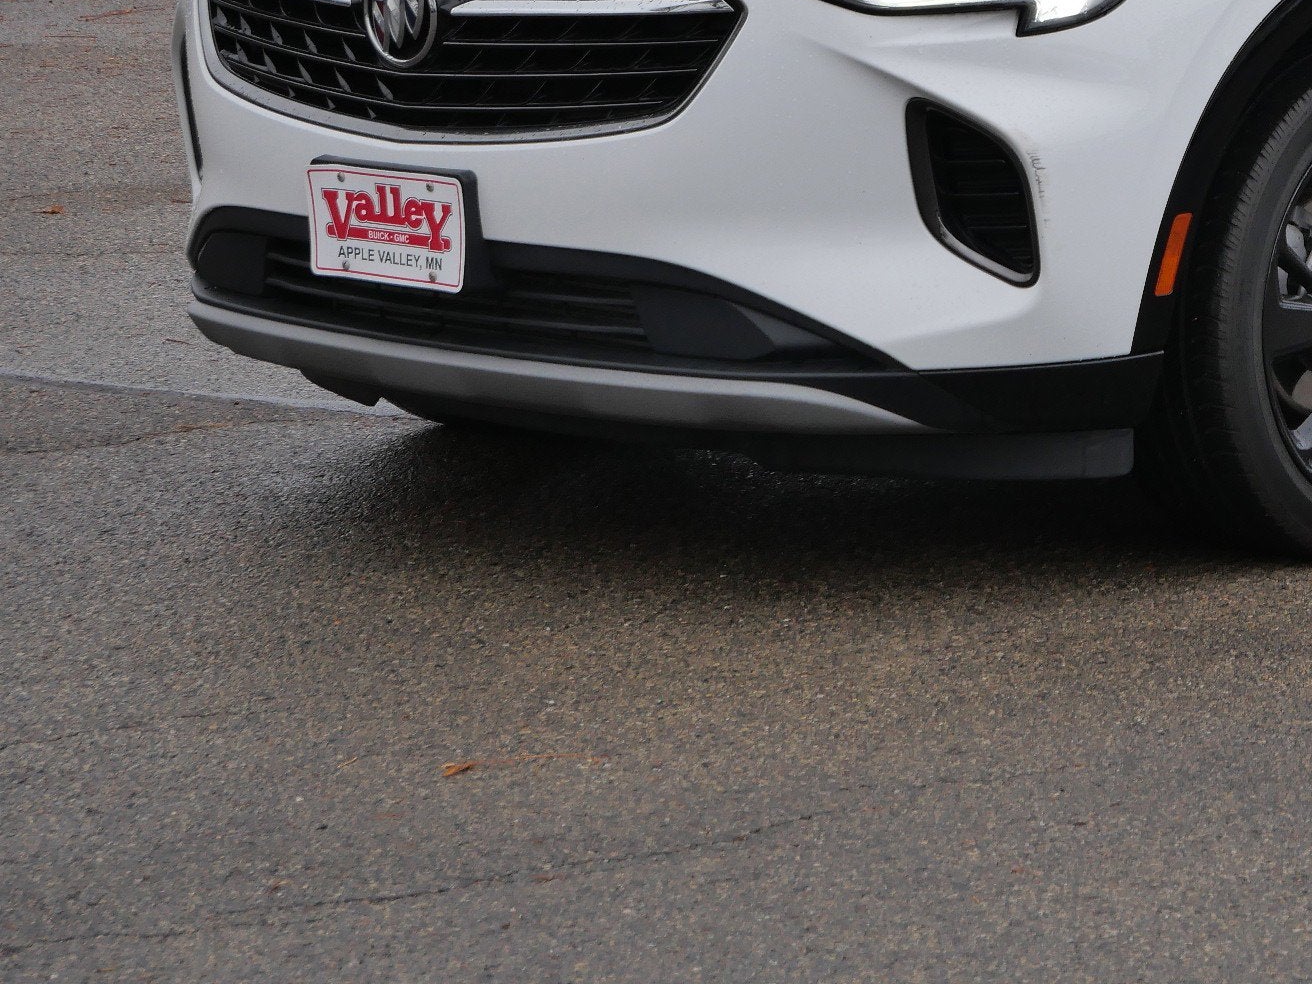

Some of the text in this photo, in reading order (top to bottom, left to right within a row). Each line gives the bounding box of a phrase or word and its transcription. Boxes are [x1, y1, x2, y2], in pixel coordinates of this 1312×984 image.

[321, 183, 452, 252] Valley
[368, 230, 410, 243] BUICK GMC
[337, 245, 443, 270] APPLE VALLEY, MN
